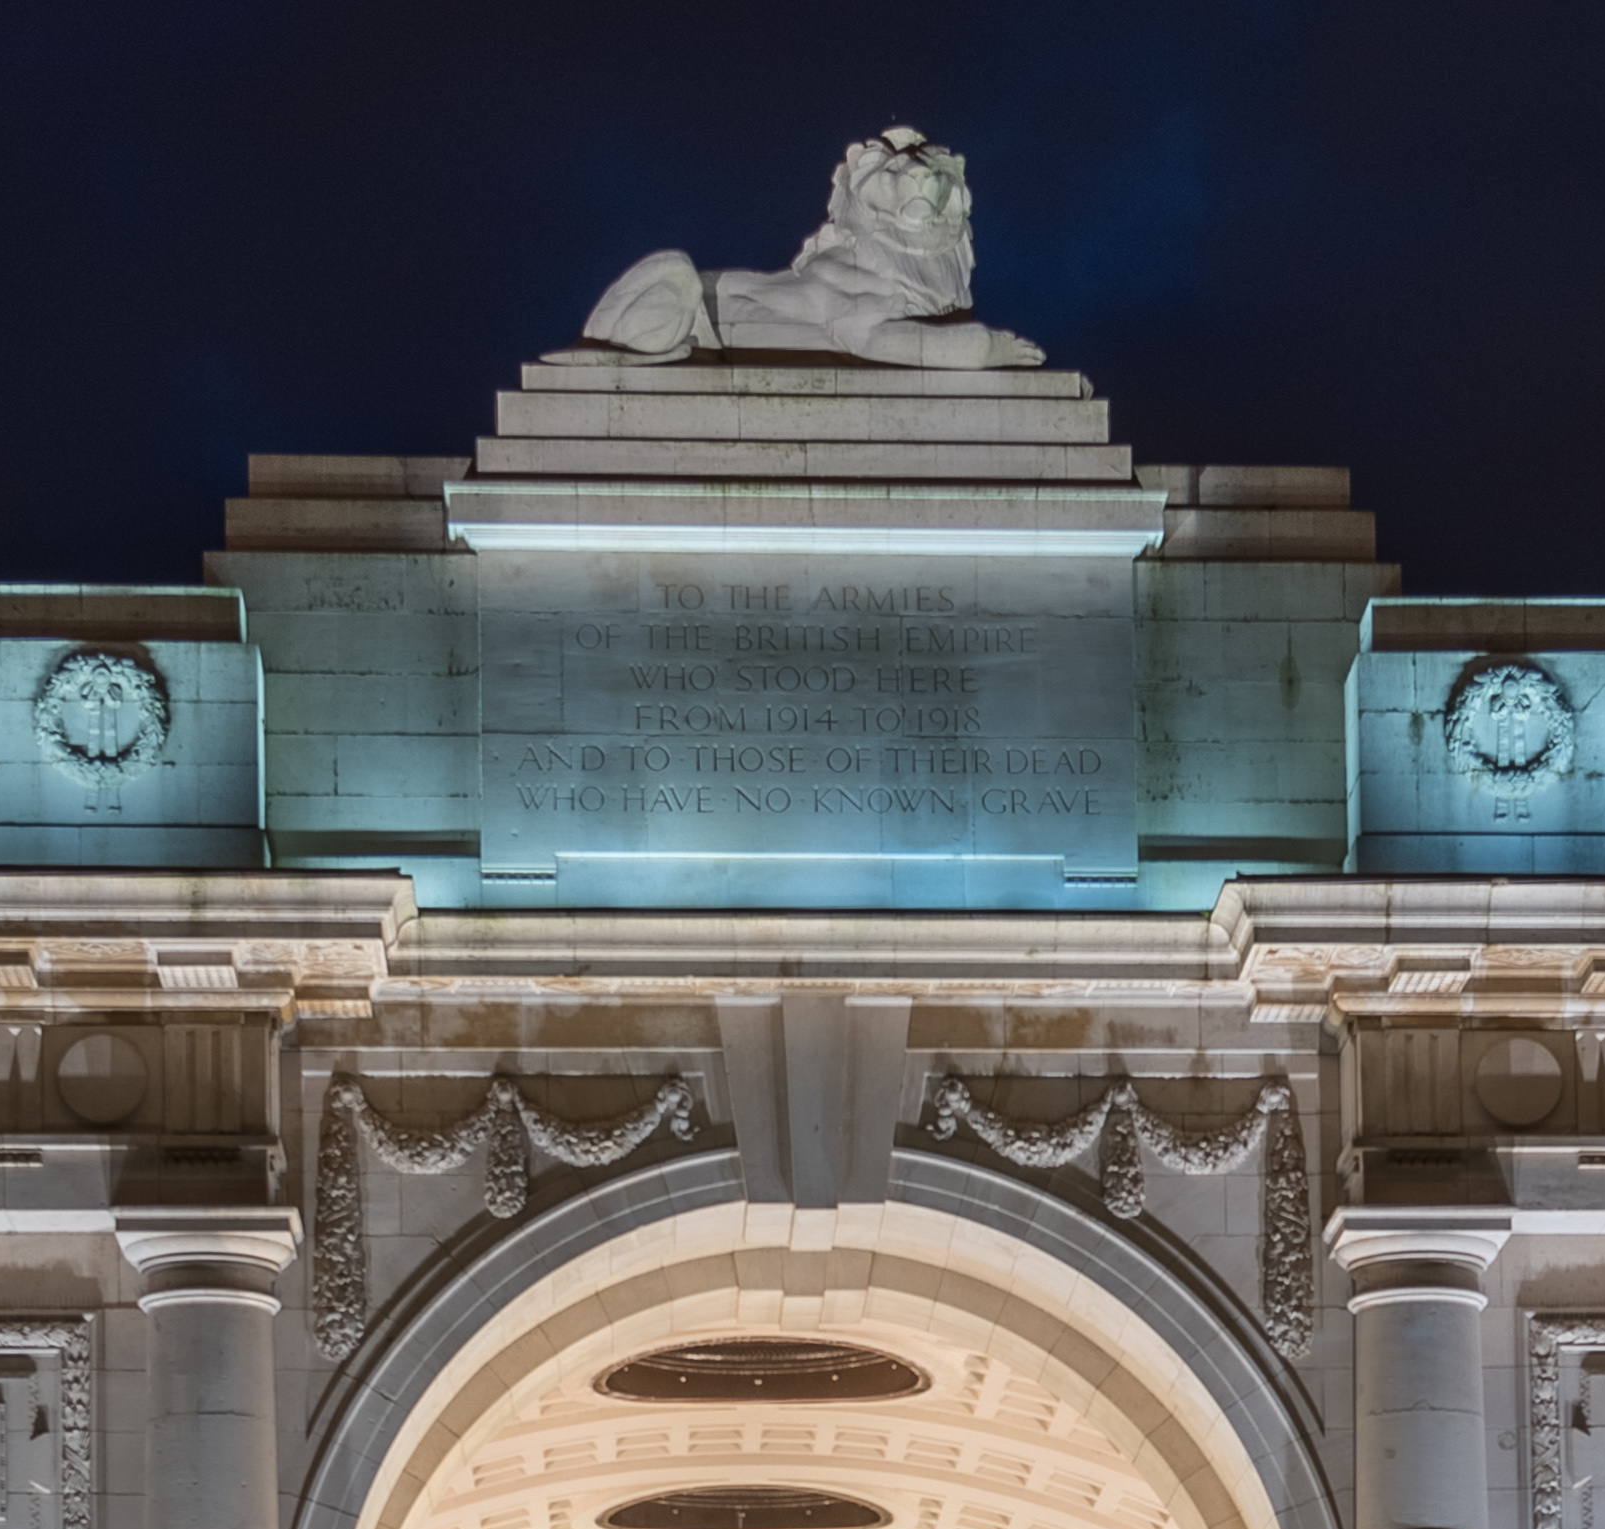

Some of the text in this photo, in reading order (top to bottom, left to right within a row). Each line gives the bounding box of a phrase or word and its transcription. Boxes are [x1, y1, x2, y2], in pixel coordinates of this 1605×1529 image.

[656, 584, 955, 612] TO THE ARMIES
[576, 623, 1037, 653] OF THE BRITISH EMPIRE
[629, 664, 979, 693] WHO STOOD HERE
[635, 705, 981, 733] FROM 1914 TO 1918
[518, 744, 1101, 775] AND TO THOSE OF THEIR DEAD
[517, 785, 1102, 815] WHO HAVE NO KNOWN GRAVE
